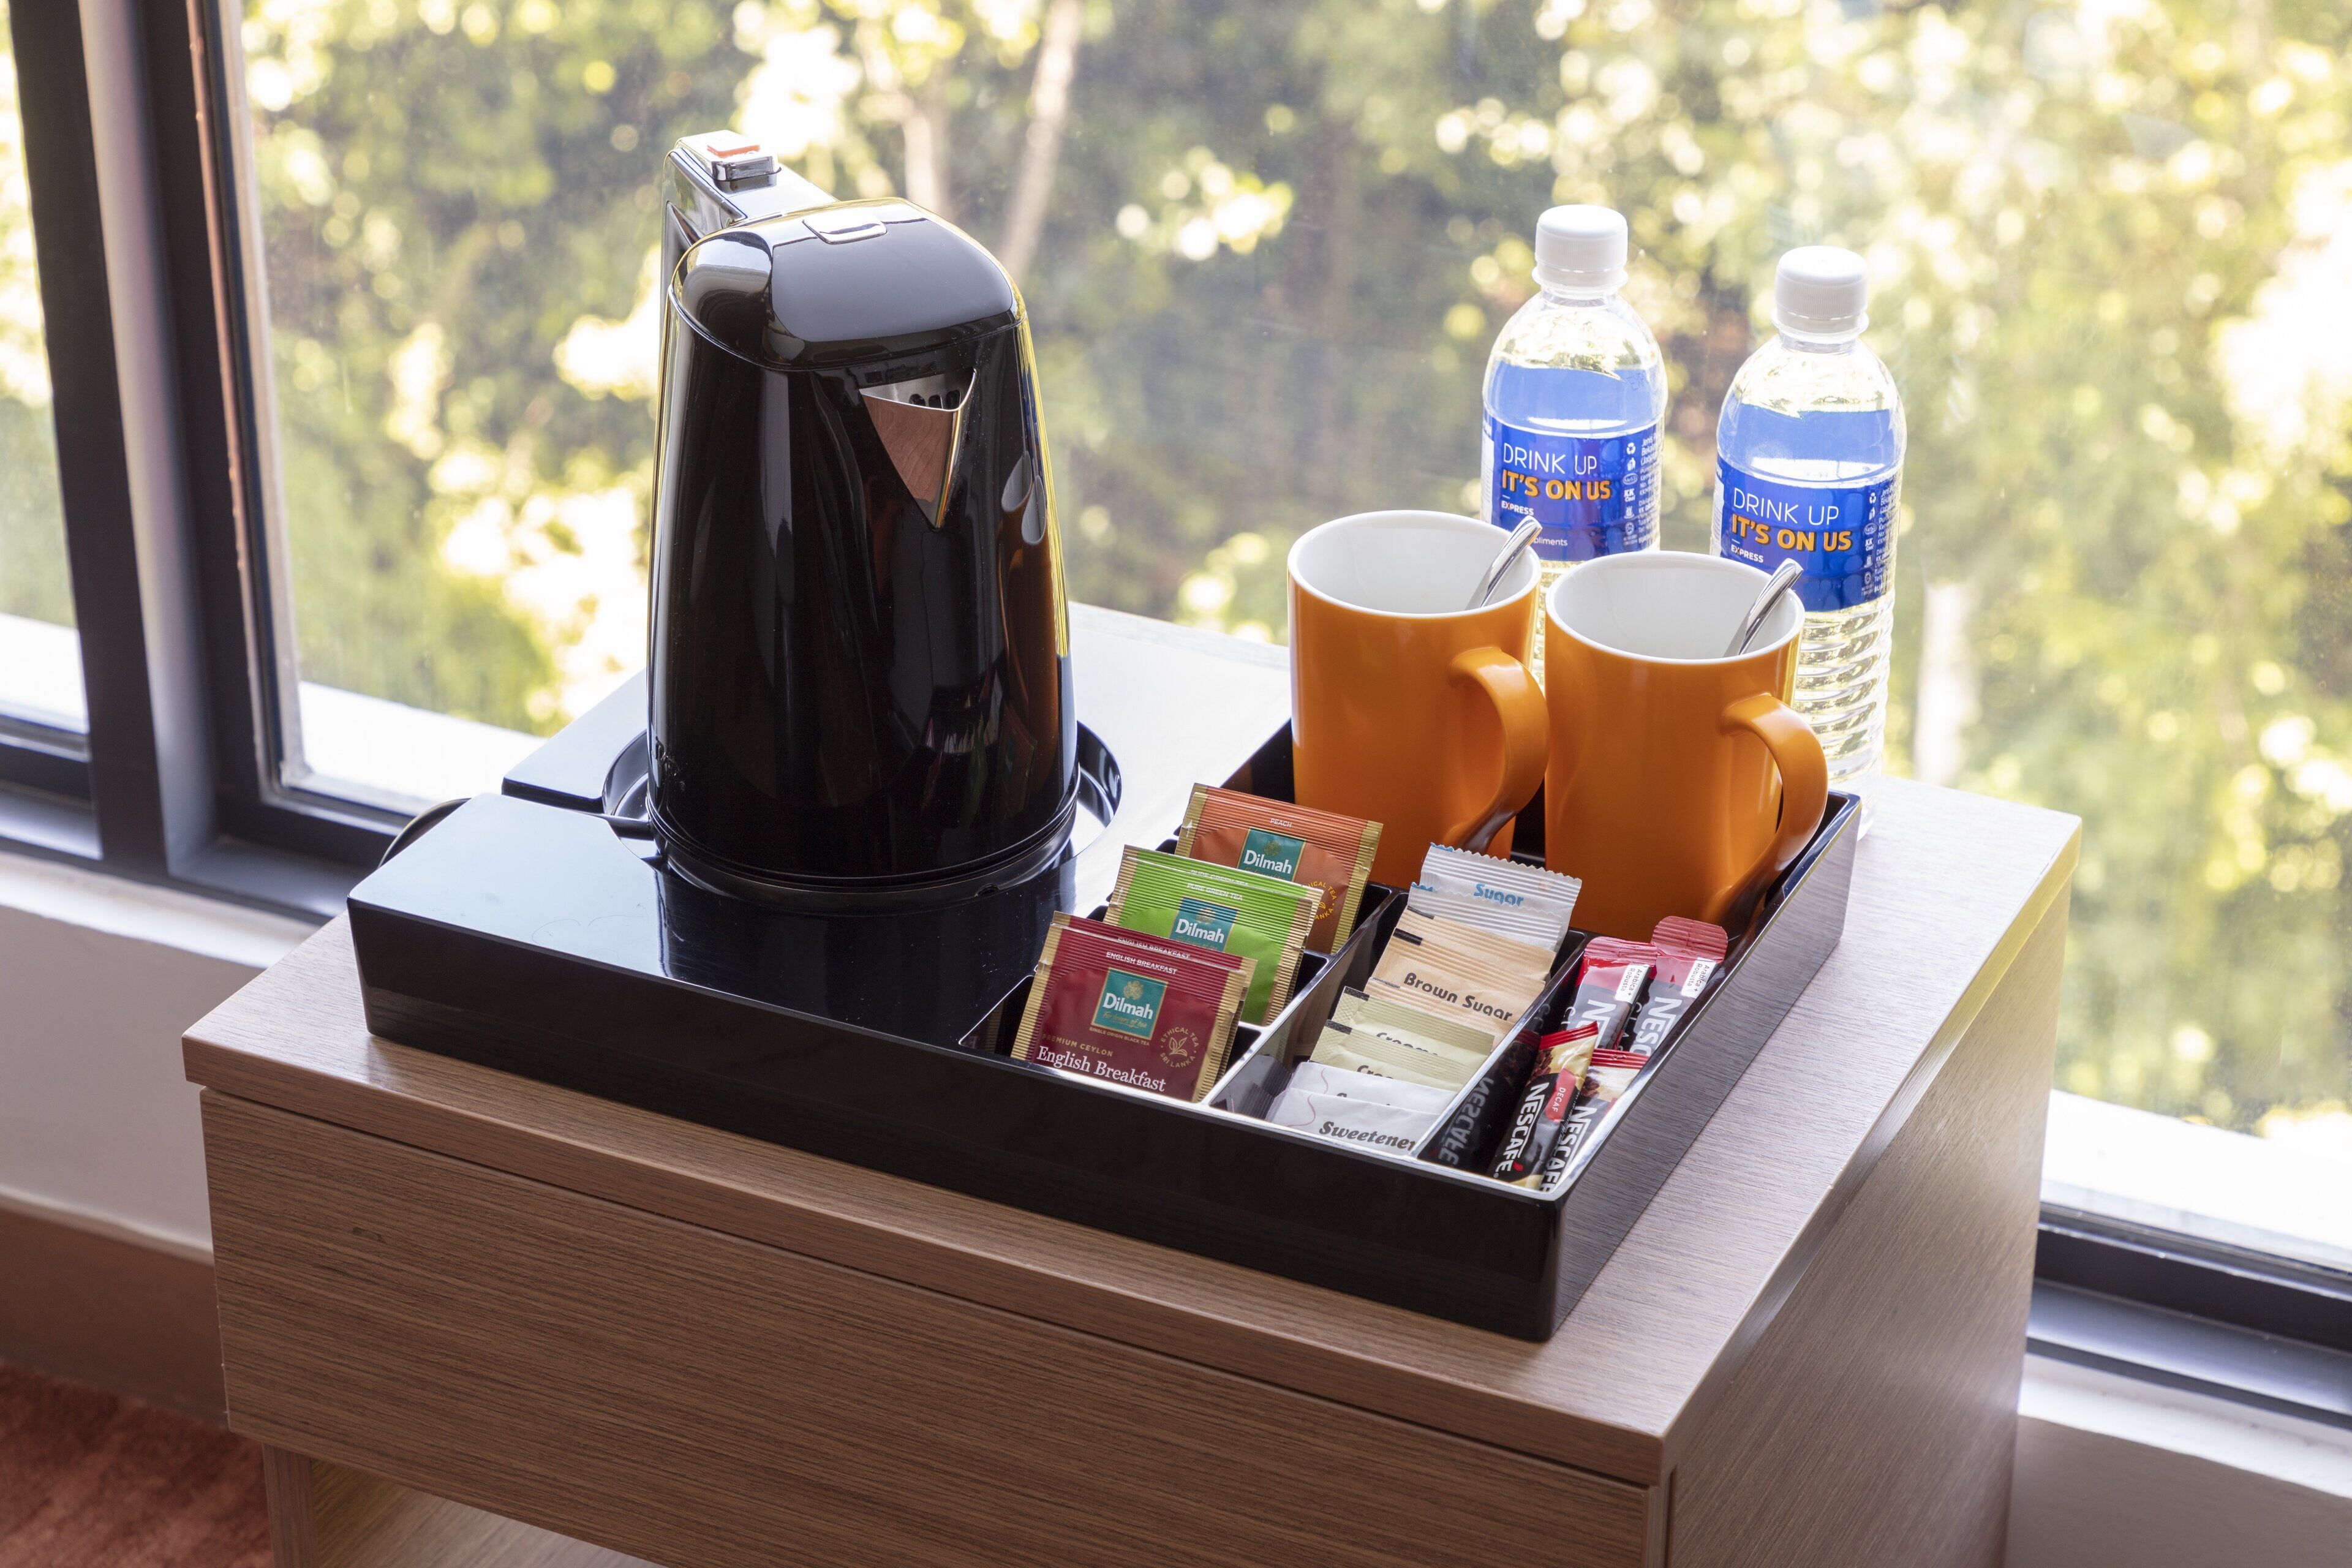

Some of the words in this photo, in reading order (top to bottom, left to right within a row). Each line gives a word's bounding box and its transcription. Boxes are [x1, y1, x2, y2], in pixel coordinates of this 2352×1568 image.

[1503, 442, 1566, 474] DRINK
[1574, 454, 1597, 475] UP
[1502, 469, 1540, 497] IT'S
[1545, 479, 1582, 500] ON
[1586, 480, 1611, 500] US
[1501, 500, 1534, 516] EXPRESS
[1734, 488, 1799, 524] DRINK
[1809, 505, 1839, 526] UP
[1732, 514, 1770, 545] IT'S
[1777, 529, 1815, 551] ON
[1823, 531, 1852, 552] US
[1731, 545, 1764, 563] EXPRESS
[1270, 818, 1293, 828] PEACH
[1243, 850, 1292, 875] Dilmah
[1186, 883, 1205, 892] PURE
[1205, 887, 1229, 897] GREEN
[1230, 892, 1243, 901] TEA
[1328, 886, 1337, 900] TEA
[1474, 883, 1524, 907] Sugar
[1314, 908, 1334, 920] ANKA
[1175, 918, 1224, 944] Dilmah
[1106, 951, 1136, 964] ENGLISH
[1136, 959, 1178, 975] BREAKFAST
[1686, 963, 1703, 987] Robusta
[1621, 968, 1635, 991] Robusta
[1629, 969, 1643, 991] Arabica
[1695, 965, 1710, 987] Arabica
[1102, 992, 1153, 1020] Dilmah
[1403, 972, 1458, 1004] Brown
[1461, 995, 1513, 1022] Sugar
[1089, 1027, 1107, 1036] SINGLE
[1107, 1031, 1124, 1039] ORIGIN
[1123, 1035, 1140, 1044] BLACK
[1160, 1027, 1189, 1042] ETHICAL
[1190, 1032, 1199, 1048] TEA
[1629, 997, 1683, 1056] NESC
[1042, 1033, 1078, 1048] PREMIUM
[1080, 1042, 1114, 1057] CEYLON
[1036, 1046, 1091, 1072] English
[1093, 1060, 1166, 1092] Breakfast
[1160, 1052, 1170, 1064] SRI
[1170, 1055, 1196, 1068] LANKA
[1552, 1087, 1566, 1112] DECAF
